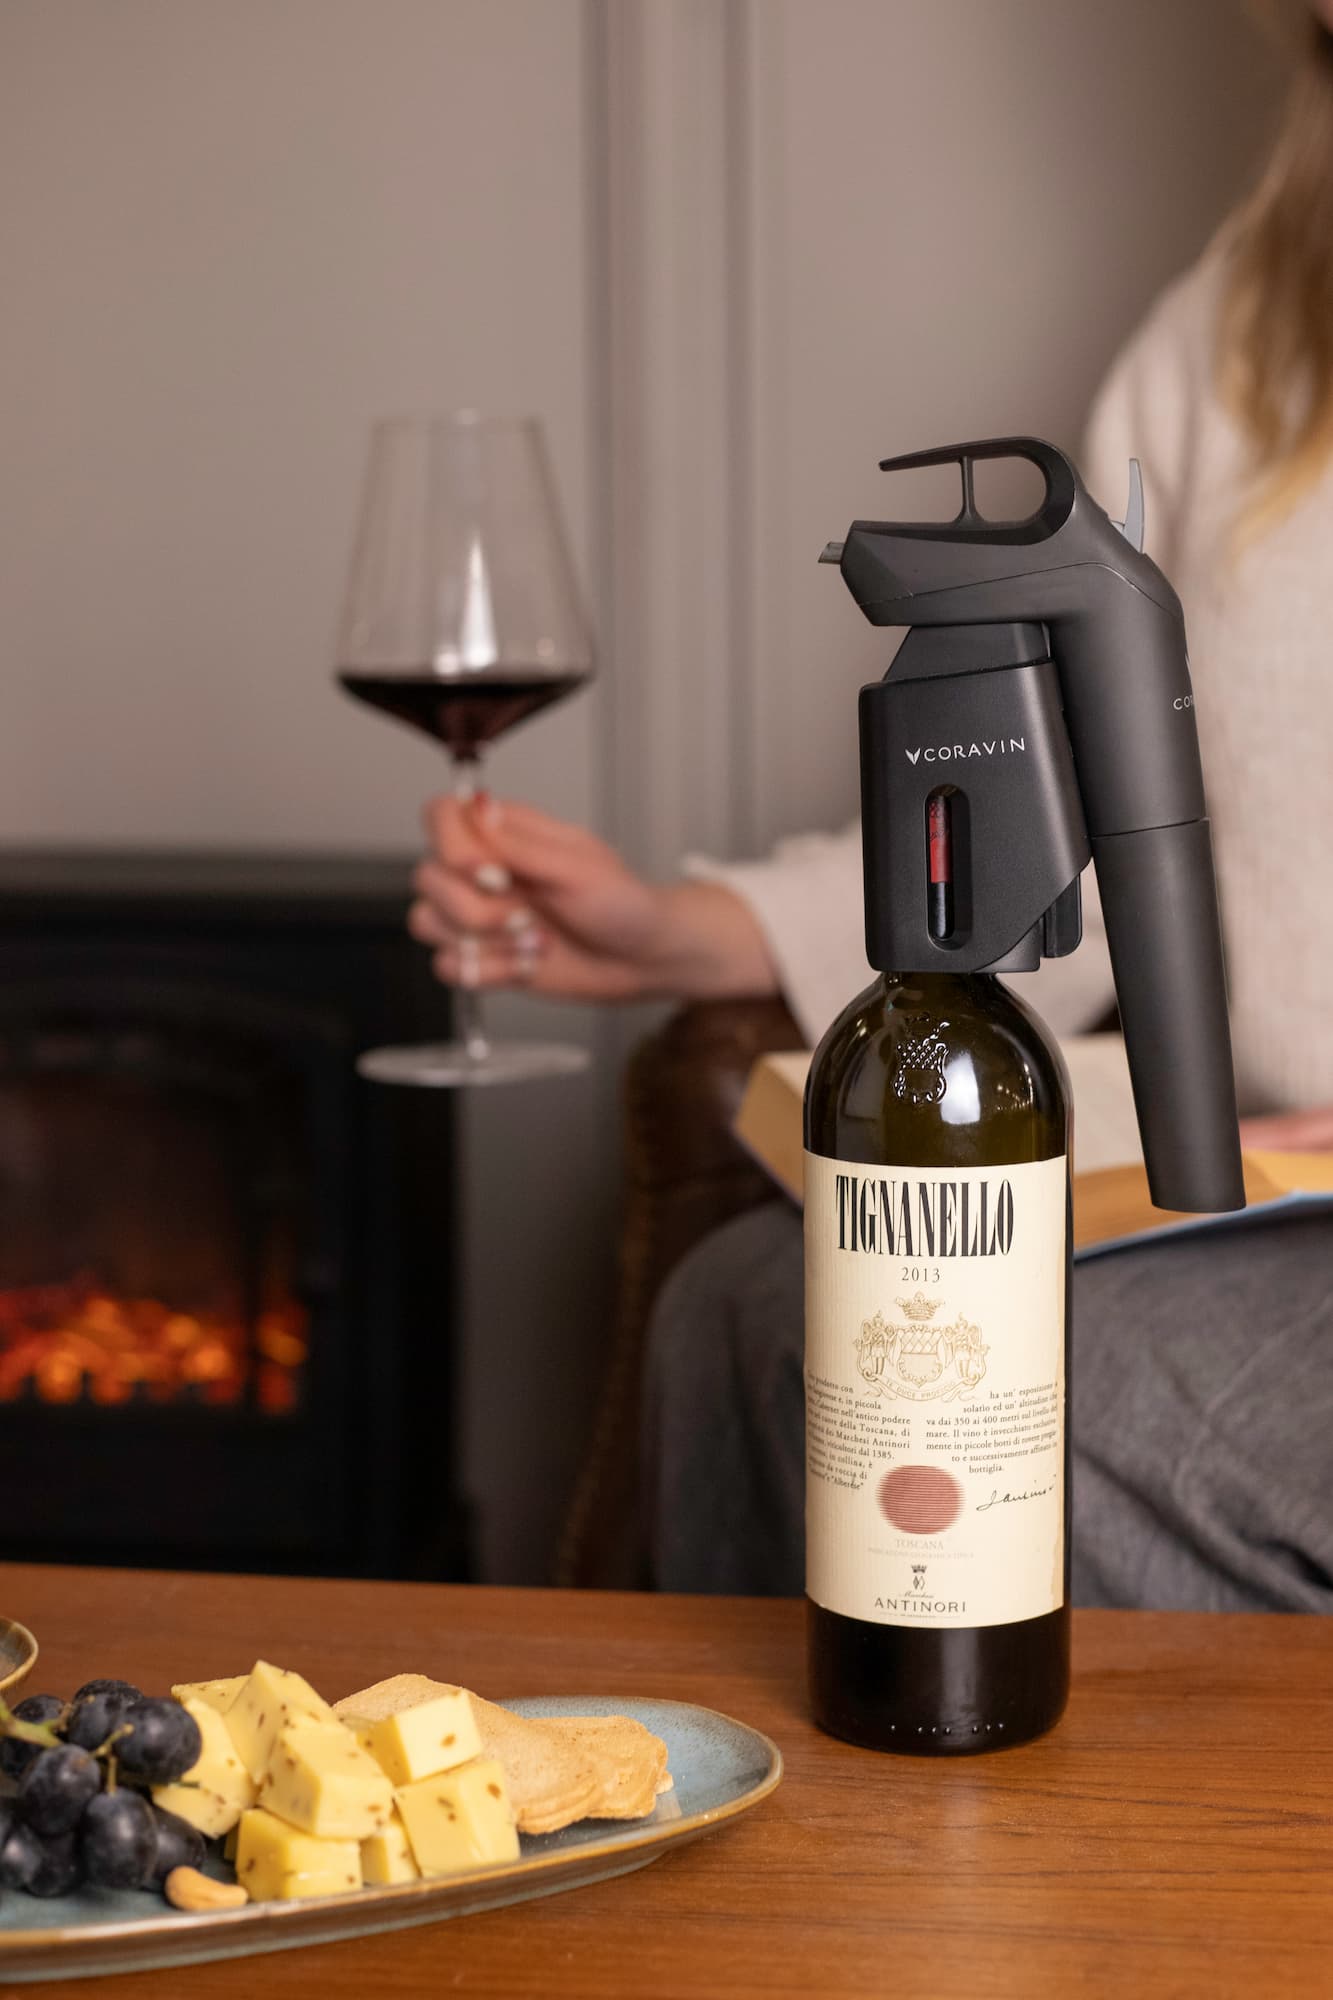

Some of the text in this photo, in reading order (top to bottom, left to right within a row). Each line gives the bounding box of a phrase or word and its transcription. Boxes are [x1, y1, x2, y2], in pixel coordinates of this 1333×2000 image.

[924, 737, 1025, 762] CORAVIN
[835, 1174, 1015, 1257] TIGNANELLO
[901, 1267, 941, 1283] 2013
[840, 1385, 854, 1393] con
[990, 1390, 999, 1400] ha
[1003, 1388, 1016, 1398] un'
[845, 1398, 853, 1406] in
[855, 1399, 881, 1411] piccola
[993, 1402, 1002, 1411] ed
[1005, 1400, 1017, 1410] un'
[882, 1415, 911, 1426] podere
[938, 1416, 951, 1426] dai
[954, 1416, 970, 1426] 350
[972, 1416, 980, 1425] ai
[982, 1415, 998, 1424] 400
[1000, 1413, 1020, 1423] metri
[1021, 1410, 1031, 1420] sul
[839, 1419, 856, 1431] della
[860, 1423, 898, 1437] Toscana,
[901, 1428, 910, 1437] di
[926, 1430, 950, 1438] mare.
[953, 1429, 960, 1438] Il
[962, 1429, 981, 1438] vino
[983, 1427, 988, 1436] è
[990, 1423, 1031, 1437] invecchiato
[836, 1430, 870, 1445] Marchesi
[872, 1438, 910, 1449] Antinori
[926, 1442, 952, 1450] mente
[954, 1441, 962, 1450] in
[964, 1439, 992, 1452] piccole
[994, 1437, 1011, 1448] botti
[1013, 1436, 1020, 1446] di
[859, 1447, 870, 1457] dal
[872, 1449, 895, 1460] 1385.
[951, 1454, 960, 1462] to
[969, 1449, 1028, 1462] successivamente
[835, 1467, 857, 1479] roccia
[859, 1471, 867, 1480] di
[896, 1538, 944, 1551] TOSCANA
[874, 1596, 966, 1613] ANTINORI
